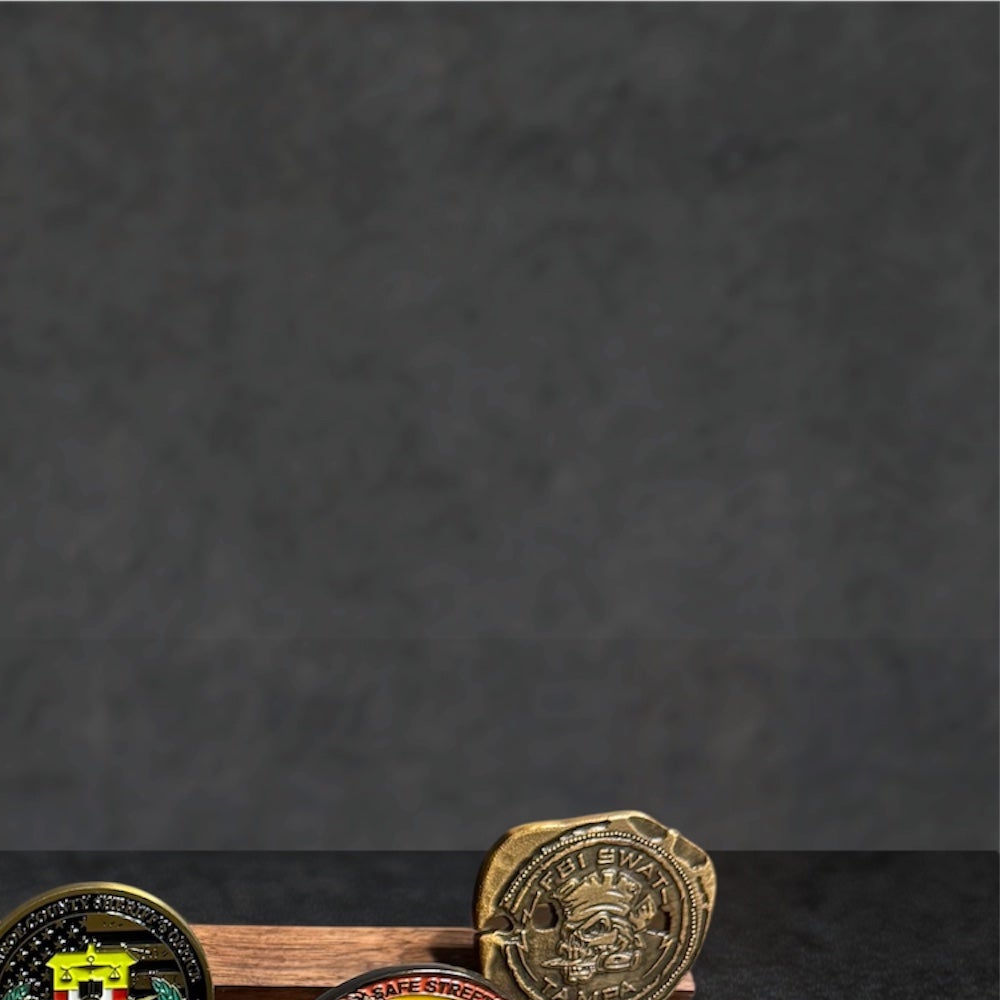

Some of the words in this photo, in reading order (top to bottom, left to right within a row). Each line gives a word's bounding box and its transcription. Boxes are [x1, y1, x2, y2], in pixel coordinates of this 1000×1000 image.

[539, 852, 587, 892] FBI
[597, 848, 669, 889] SWAT
[372, 979, 421, 999] SAFE
